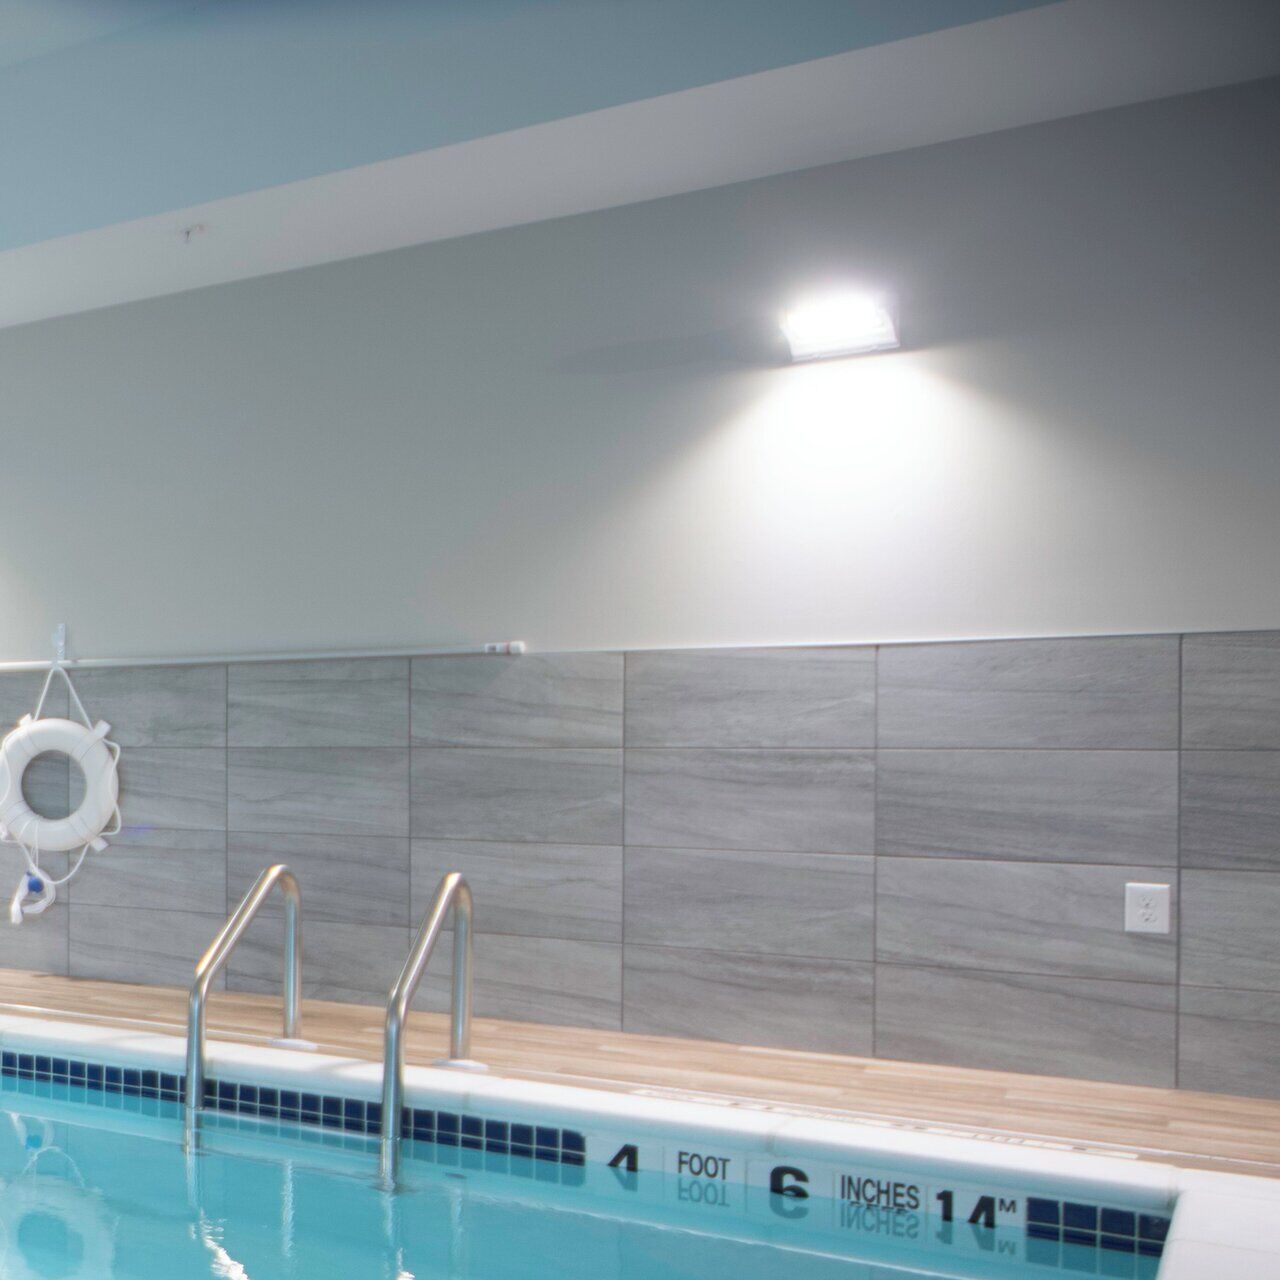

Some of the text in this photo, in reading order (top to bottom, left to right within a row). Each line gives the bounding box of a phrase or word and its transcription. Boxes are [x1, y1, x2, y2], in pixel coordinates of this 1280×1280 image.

[678, 1151, 731, 1181] FOOT
[770, 1165, 809, 1199] 6
[841, 1174, 921, 1210] INCHES
